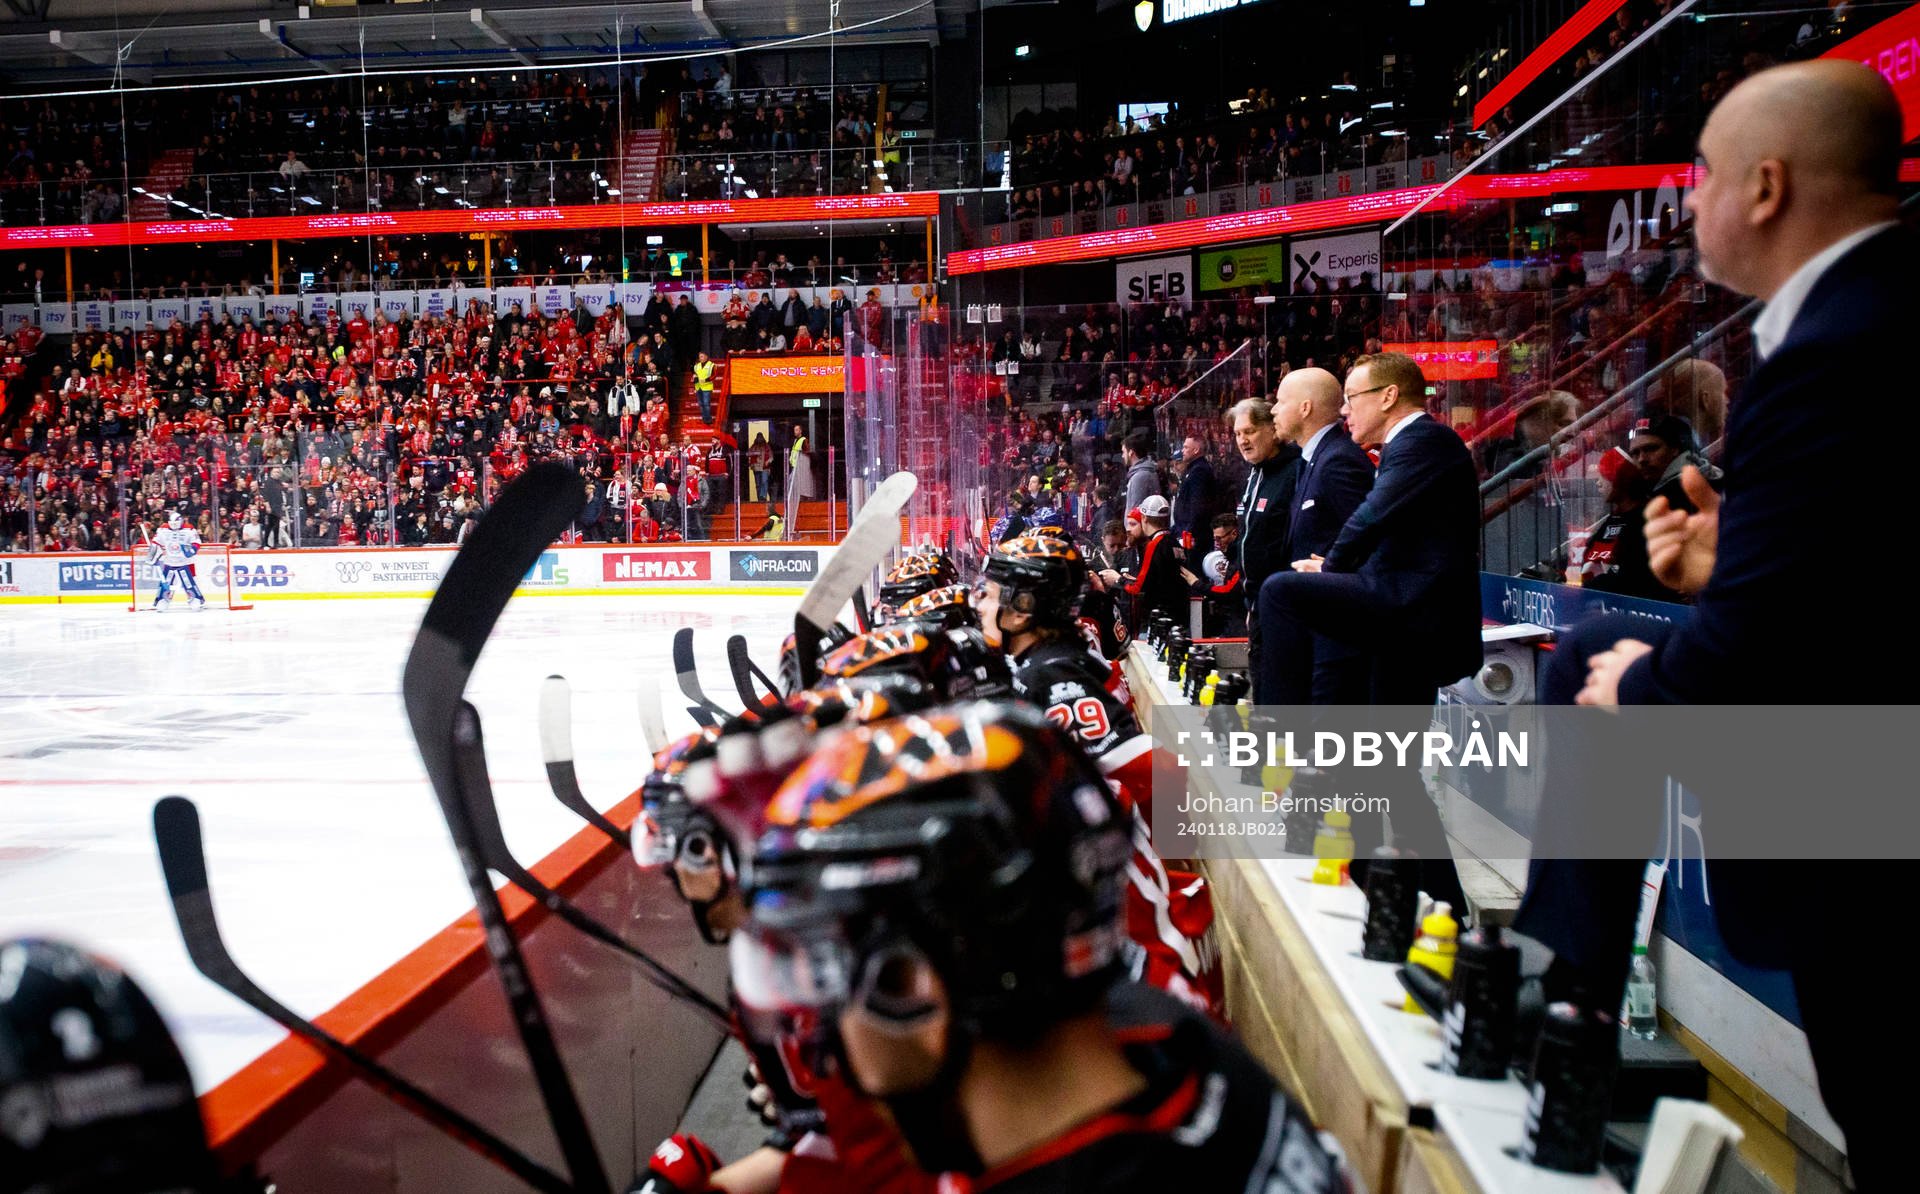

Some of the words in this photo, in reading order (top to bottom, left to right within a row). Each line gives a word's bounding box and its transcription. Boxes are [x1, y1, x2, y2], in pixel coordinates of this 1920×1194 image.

[1328, 250, 1378, 270] Experis
[1128, 272, 1185, 301] SEB
[582, 295, 603, 305] itsy
[233, 306, 253, 316] itsy
[347, 302, 368, 312] itsy
[386, 301, 407, 311] itsy
[46, 312, 65, 323] itsy
[120, 310, 141, 320] itsy
[158, 309, 178, 318] itsy
[761, 366, 807, 378] NORDIC
[810, 366, 846, 376] RENT
[750, 559, 811, 572] INFRA-CON
[373, 572, 440, 581] FASTIGHETER
[1512, 588, 1555, 628] BJURFORS
